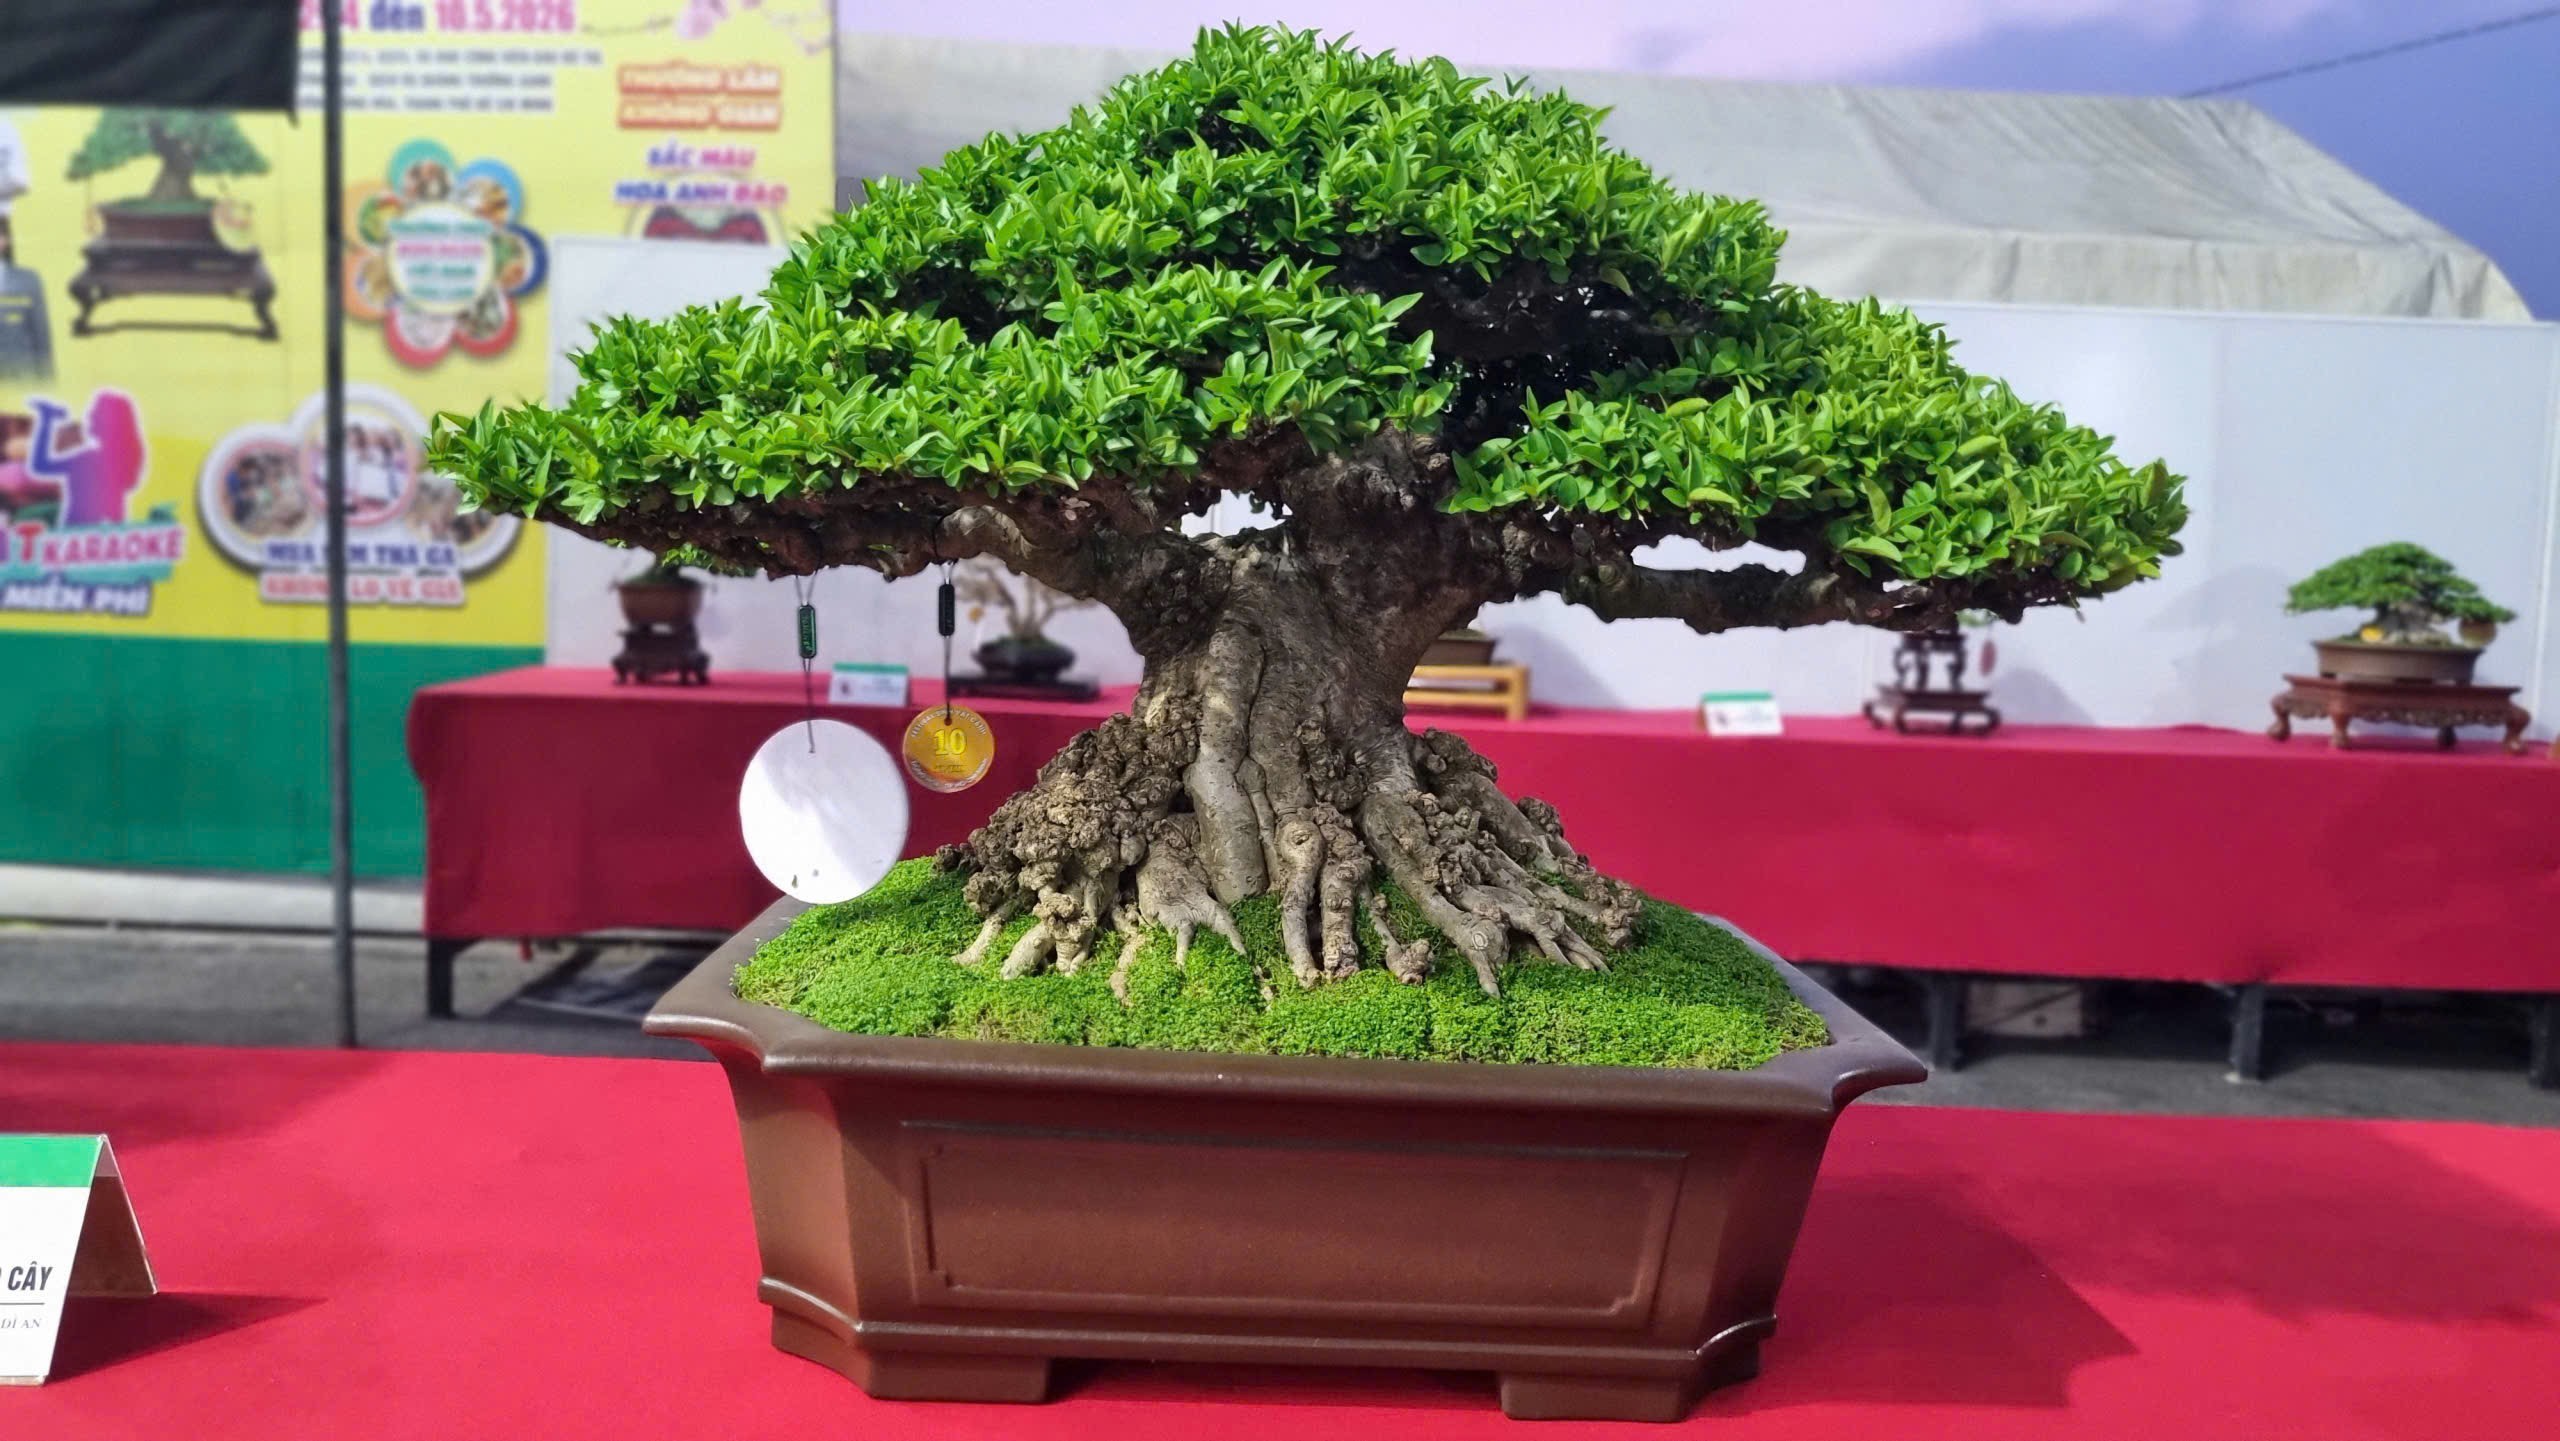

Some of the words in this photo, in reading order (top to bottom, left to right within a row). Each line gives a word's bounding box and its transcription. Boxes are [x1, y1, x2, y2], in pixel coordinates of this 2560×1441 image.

[934, 727, 967, 755] 10
[8, 1260, 54, 1291] CÂY
[21, 1318, 43, 1329] AN
